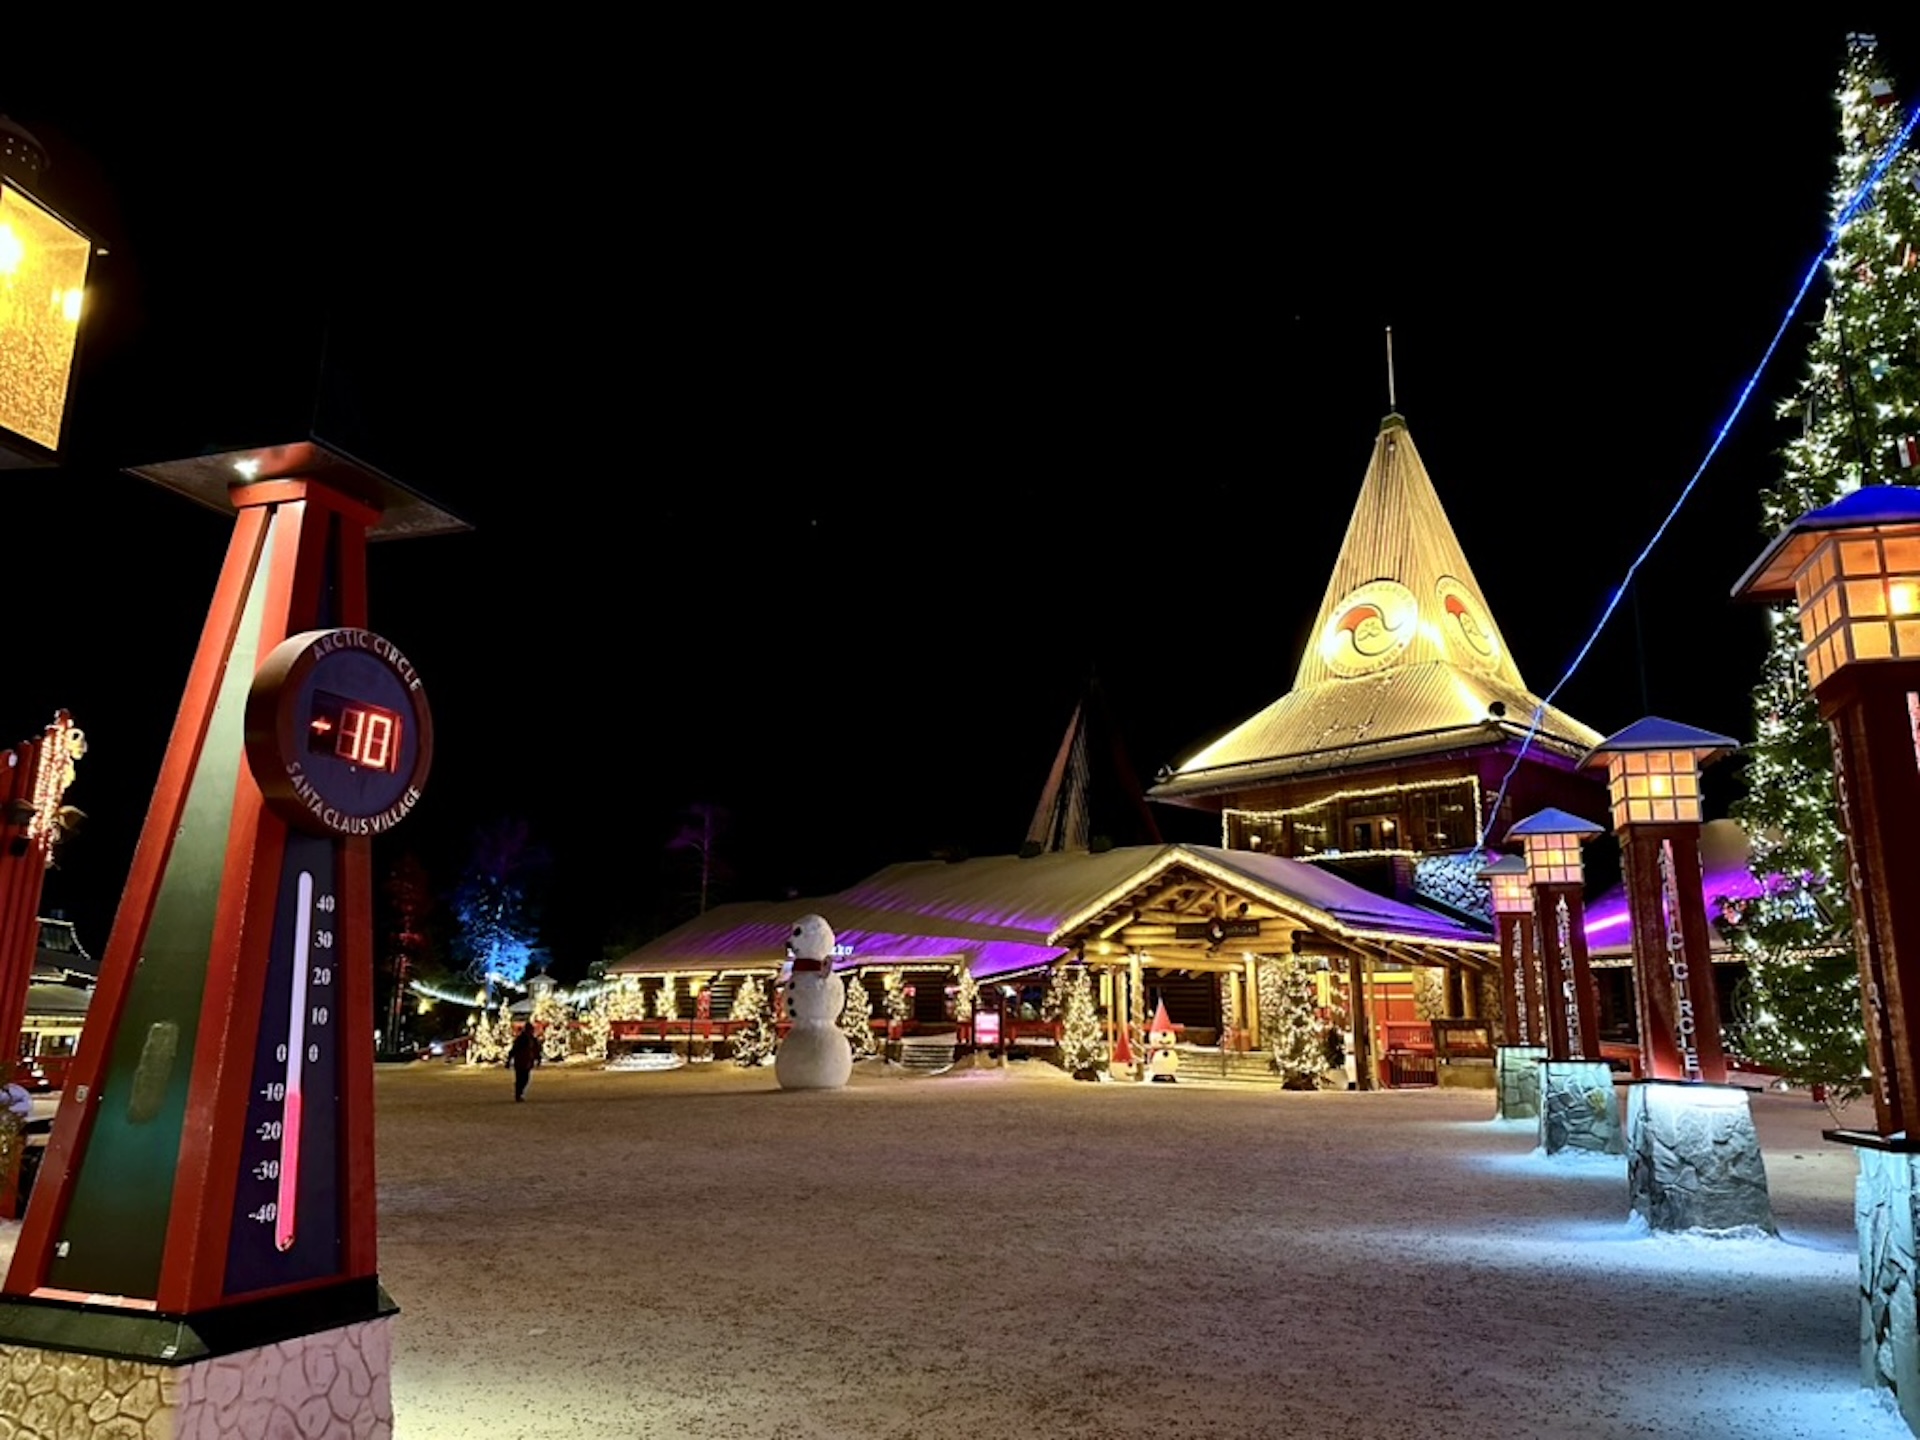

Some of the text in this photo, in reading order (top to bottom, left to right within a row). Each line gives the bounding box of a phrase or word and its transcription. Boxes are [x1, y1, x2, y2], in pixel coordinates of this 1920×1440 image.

[313, 630, 423, 691] ARCTIC CIRCLE
[286, 761, 422, 835] SANTA CLAUS VILLAGE
[316, 895, 335, 912] 40
[314, 930, 332, 948] 30
[312, 967, 331, 985] 20
[311, 1007, 327, 1025] 10
[1673, 962, 1700, 1072] CIRCLE
[276, 1043, 287, 1062] 0
[308, 1043, 318, 1062] 0
[260, 1081, 284, 1101] -10
[256, 1119, 282, 1140] -20
[252, 1160, 279, 1180] -30
[248, 1202, 276, 1222] -40
